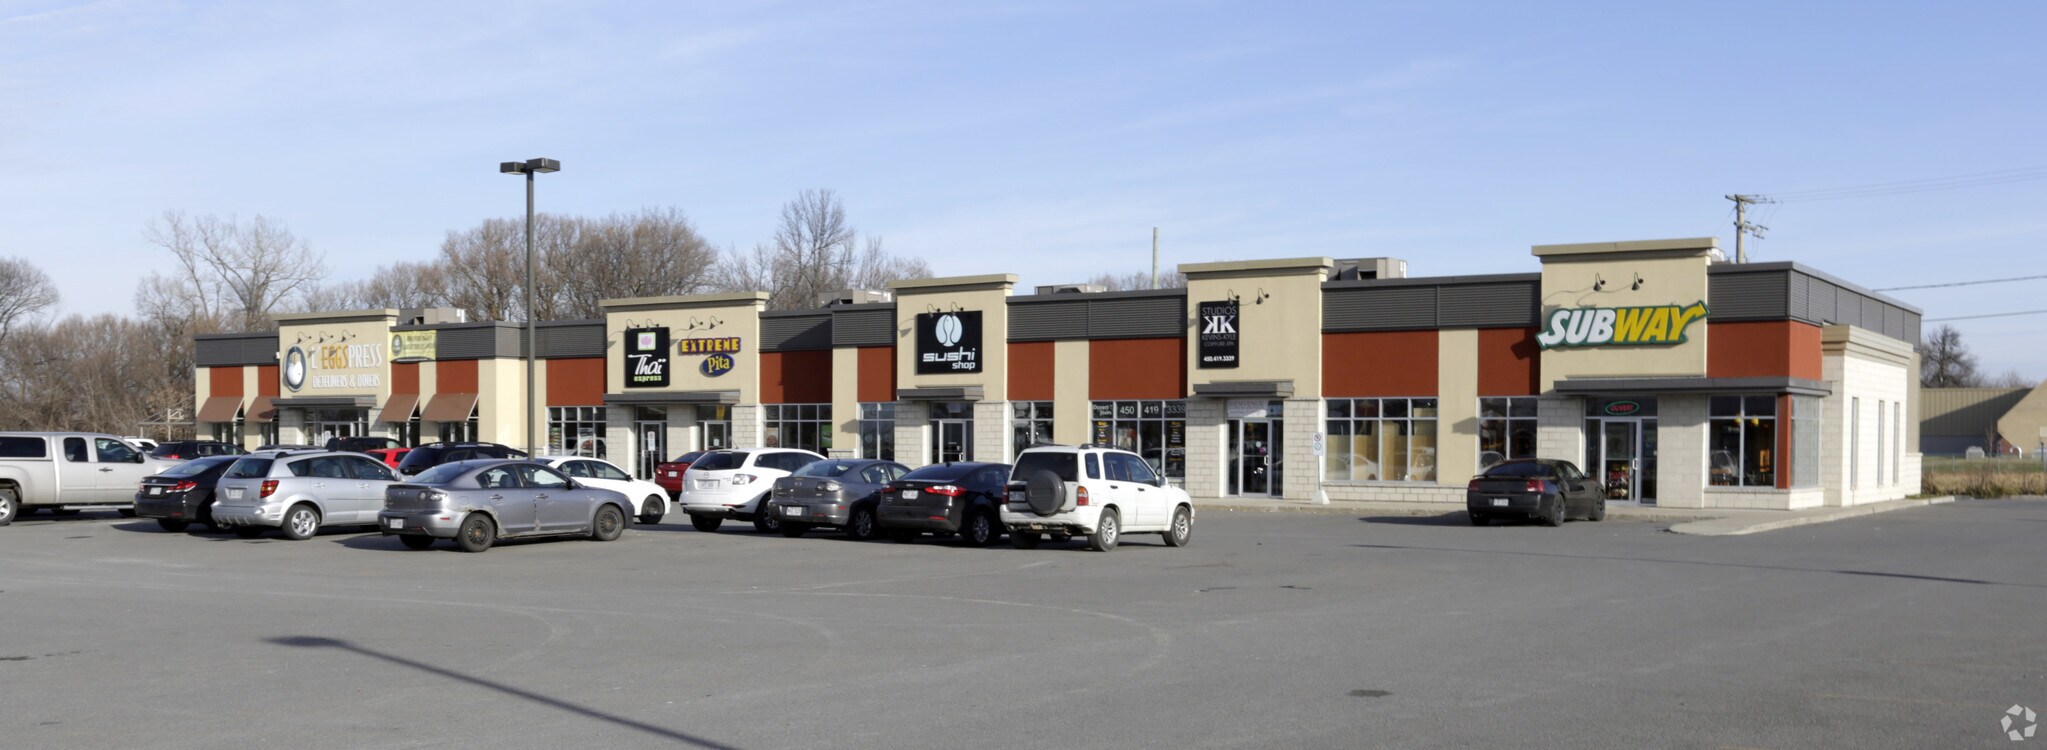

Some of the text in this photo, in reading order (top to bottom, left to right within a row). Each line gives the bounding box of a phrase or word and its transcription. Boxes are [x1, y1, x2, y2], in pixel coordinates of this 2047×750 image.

[1202, 306, 1237, 316] STUDIOS
[1538, 303, 1707, 346] SUBWAY
[681, 338, 740, 352] EXTREME
[922, 346, 976, 362] sushi
[707, 355, 731, 373] Pita
[951, 361, 976, 370] shop
[350, 375, 355, 387] &
[1120, 405, 1135, 415] 450
[1144, 405, 1159, 415] 419
[1167, 405, 1185, 414] 3339
[1610, 404, 1633, 412] OUVERT
